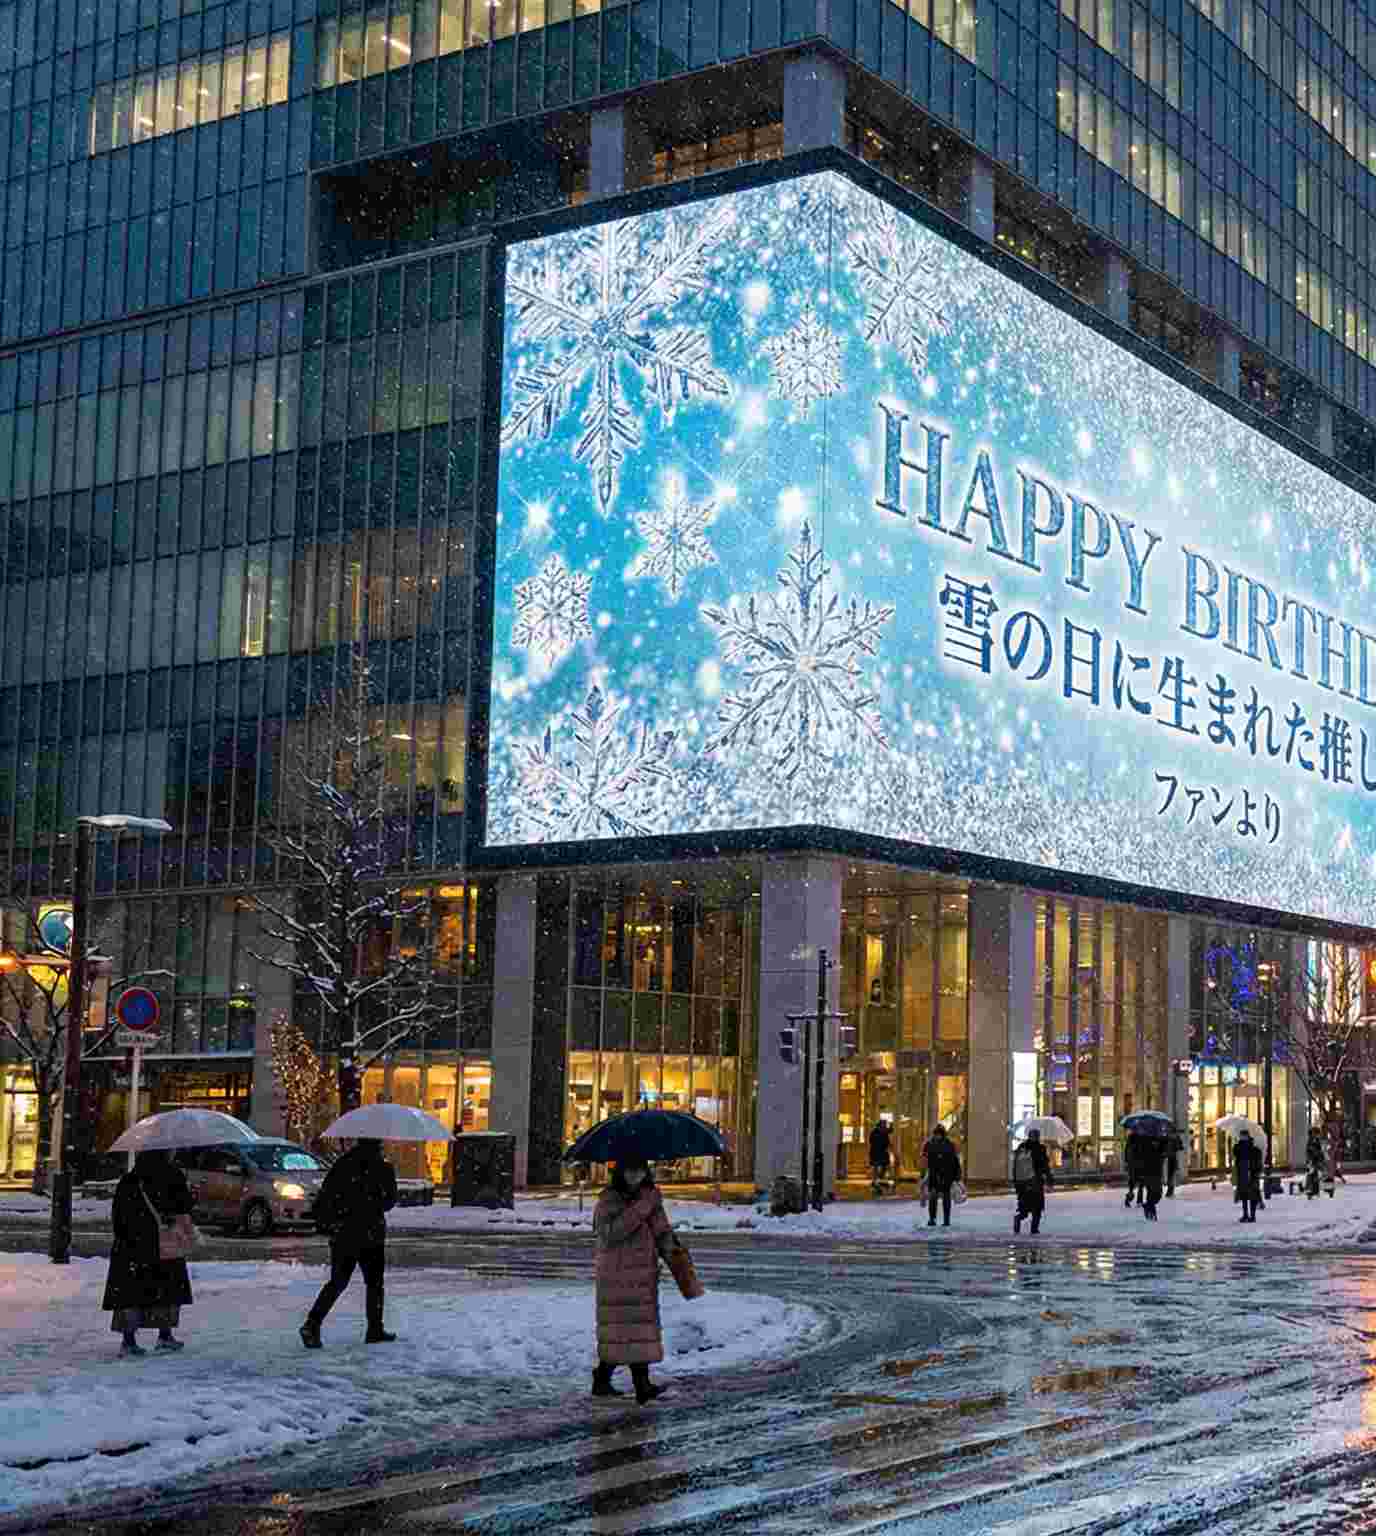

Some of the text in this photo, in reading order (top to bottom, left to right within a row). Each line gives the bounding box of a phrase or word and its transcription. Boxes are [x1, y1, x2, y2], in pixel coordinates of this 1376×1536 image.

[875, 401, 1162, 616] HAPPY
[1153, 768, 1281, 844] ファンより
